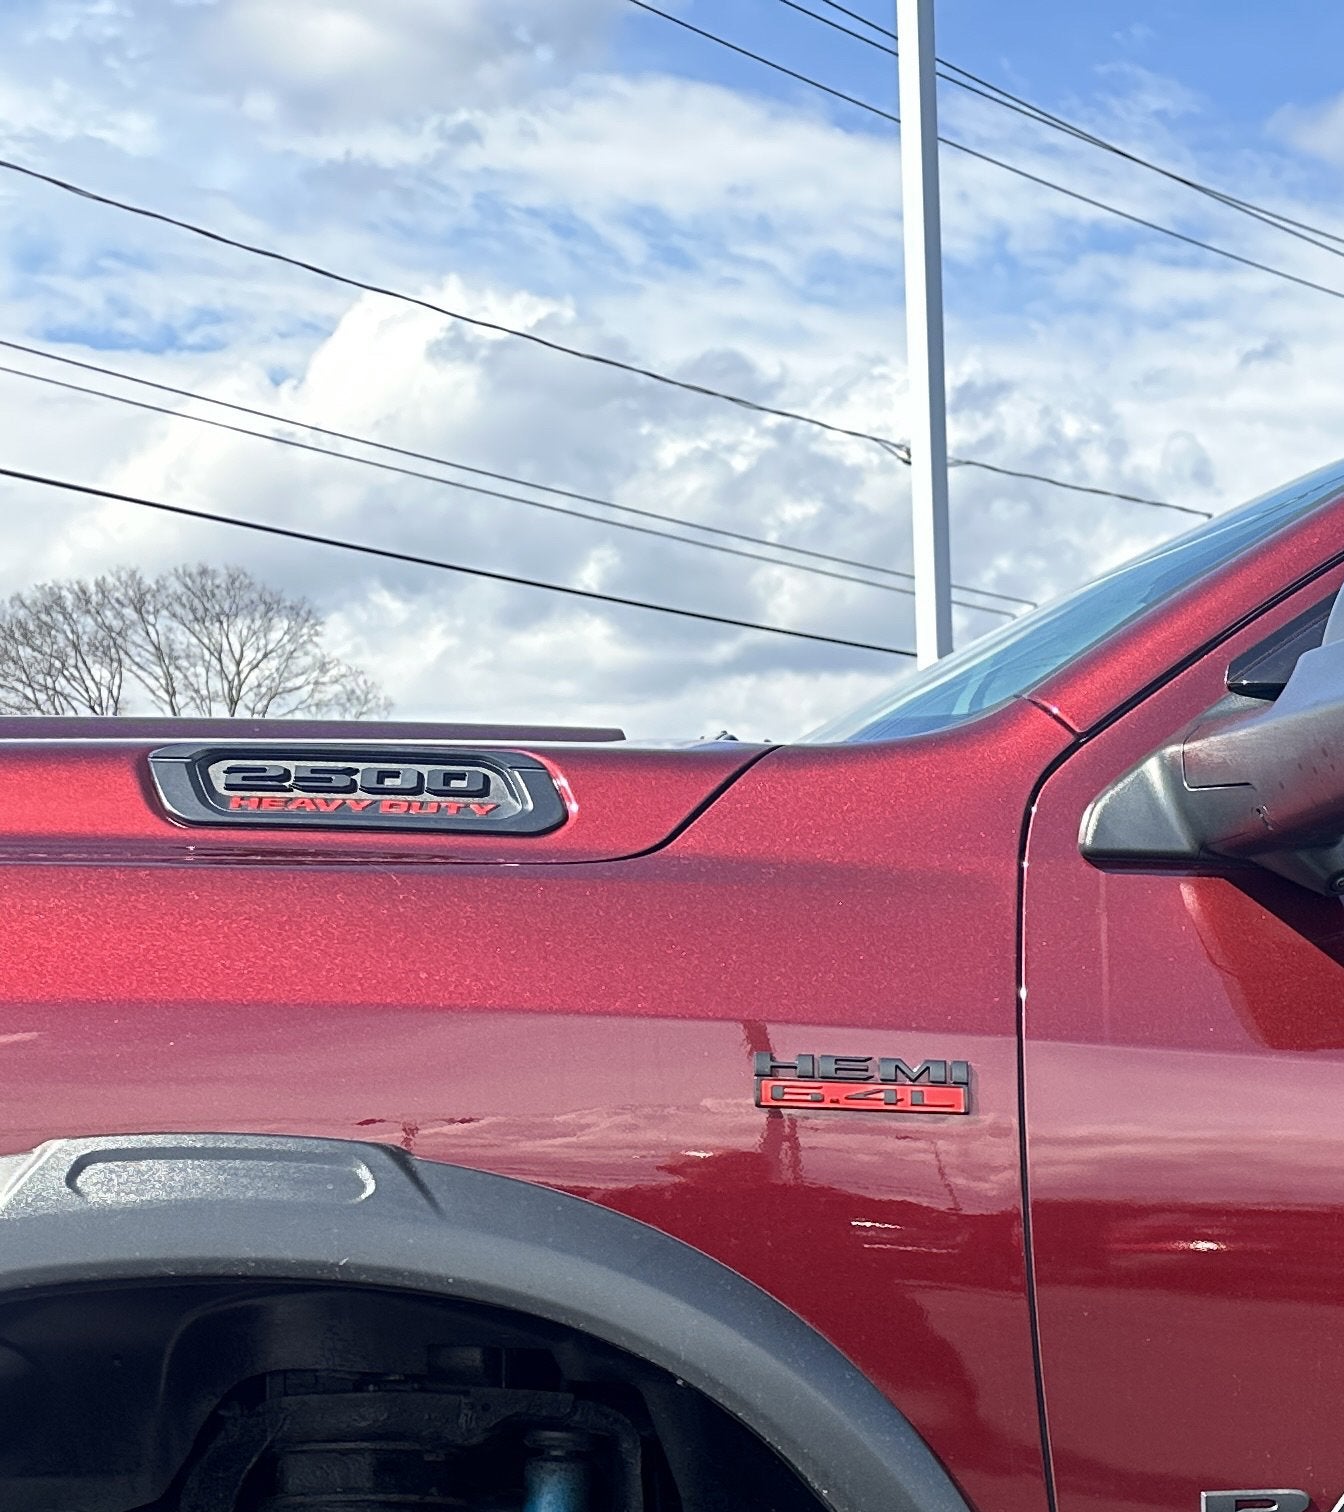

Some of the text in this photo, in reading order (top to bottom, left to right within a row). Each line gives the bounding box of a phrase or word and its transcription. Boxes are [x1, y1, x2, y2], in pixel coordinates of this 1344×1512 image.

[223, 764, 491, 798] 2500
[229, 796, 501, 817] HEAVY DUTY
[754, 1052, 970, 1085] HEMI
[771, 1084, 955, 1108] 6.4L
